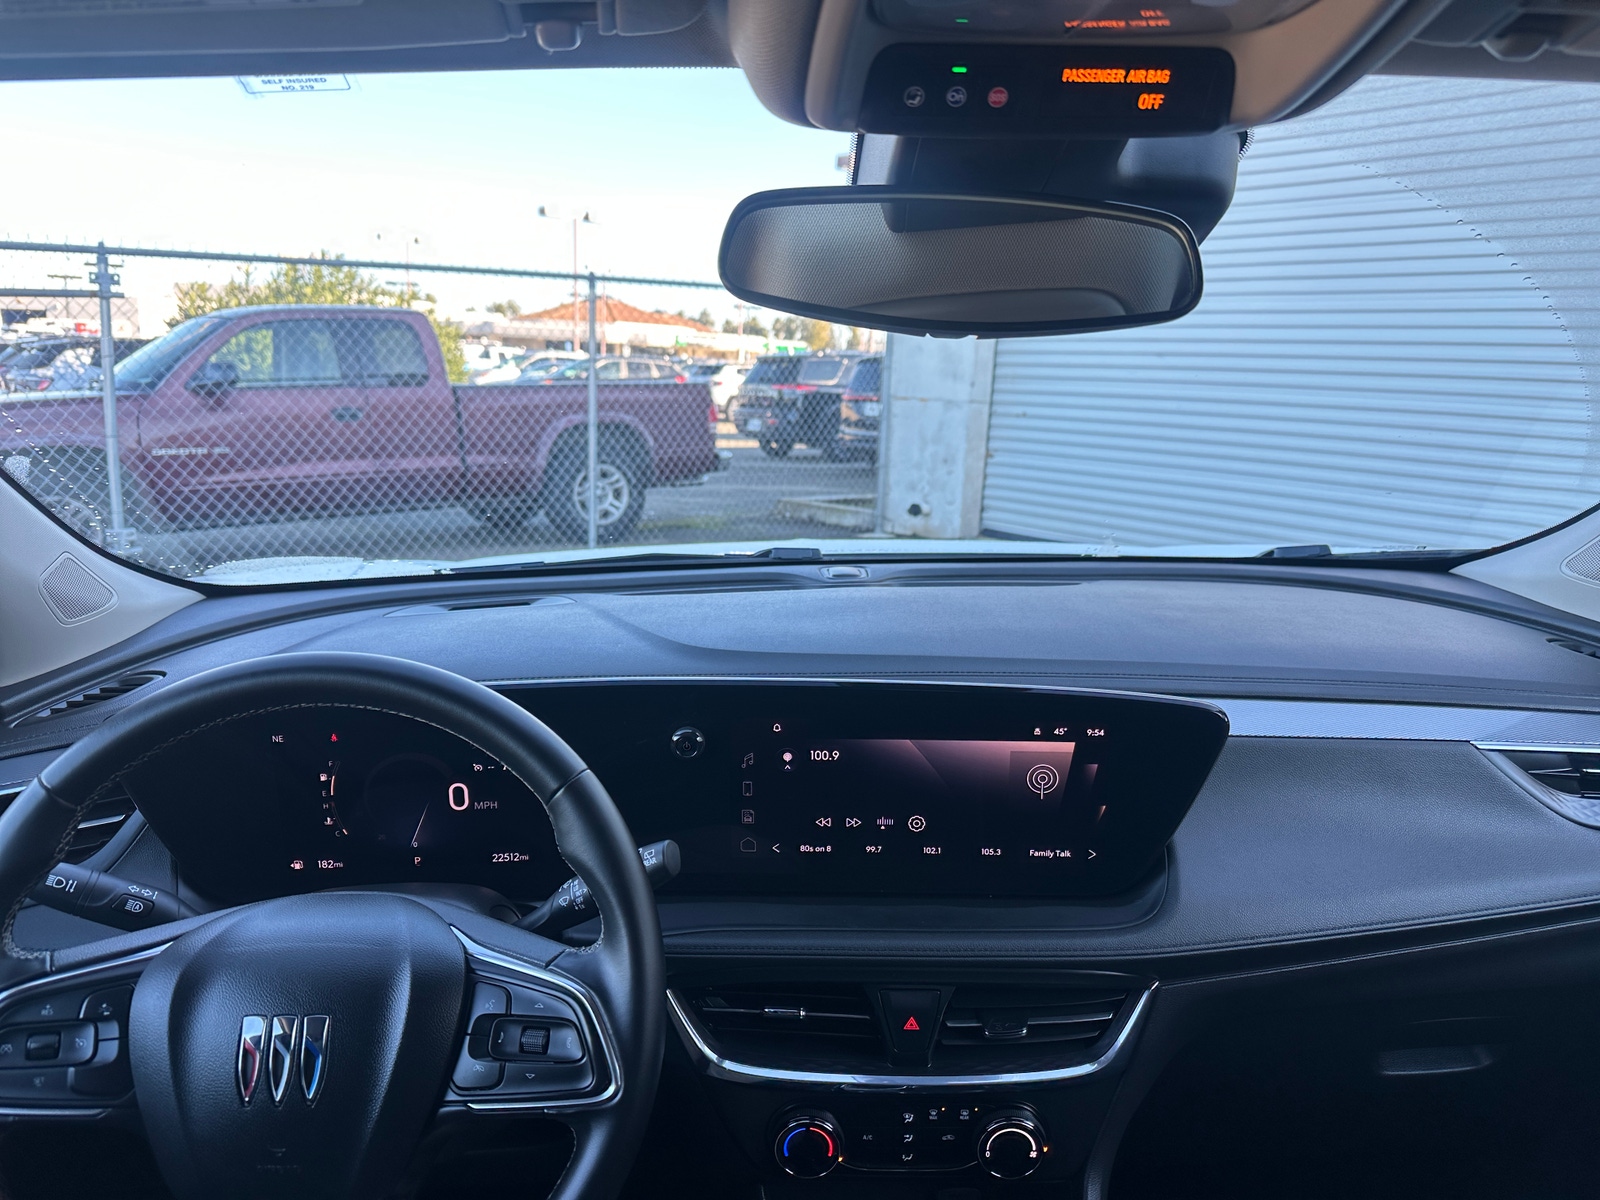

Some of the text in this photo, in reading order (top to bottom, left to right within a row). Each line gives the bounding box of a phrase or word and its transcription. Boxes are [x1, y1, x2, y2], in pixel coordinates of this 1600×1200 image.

[1061, 68, 1126, 83] PASSENGER
[1137, 93, 1165, 110] OFF
[1086, 728, 1105, 737] 9:54
[271, 735, 284, 743] NE
[809, 750, 840, 761] 100.9
[448, 782, 498, 811] 0 MPH
[799, 844, 814, 853] 80s
[826, 845, 832, 853] 8
[865, 845, 882, 853] 99.7
[923, 846, 941, 855] 102.1
[981, 848, 1001, 857] 105.3
[1029, 849, 1072, 859] Family Talk
[414, 856, 421, 864] P
